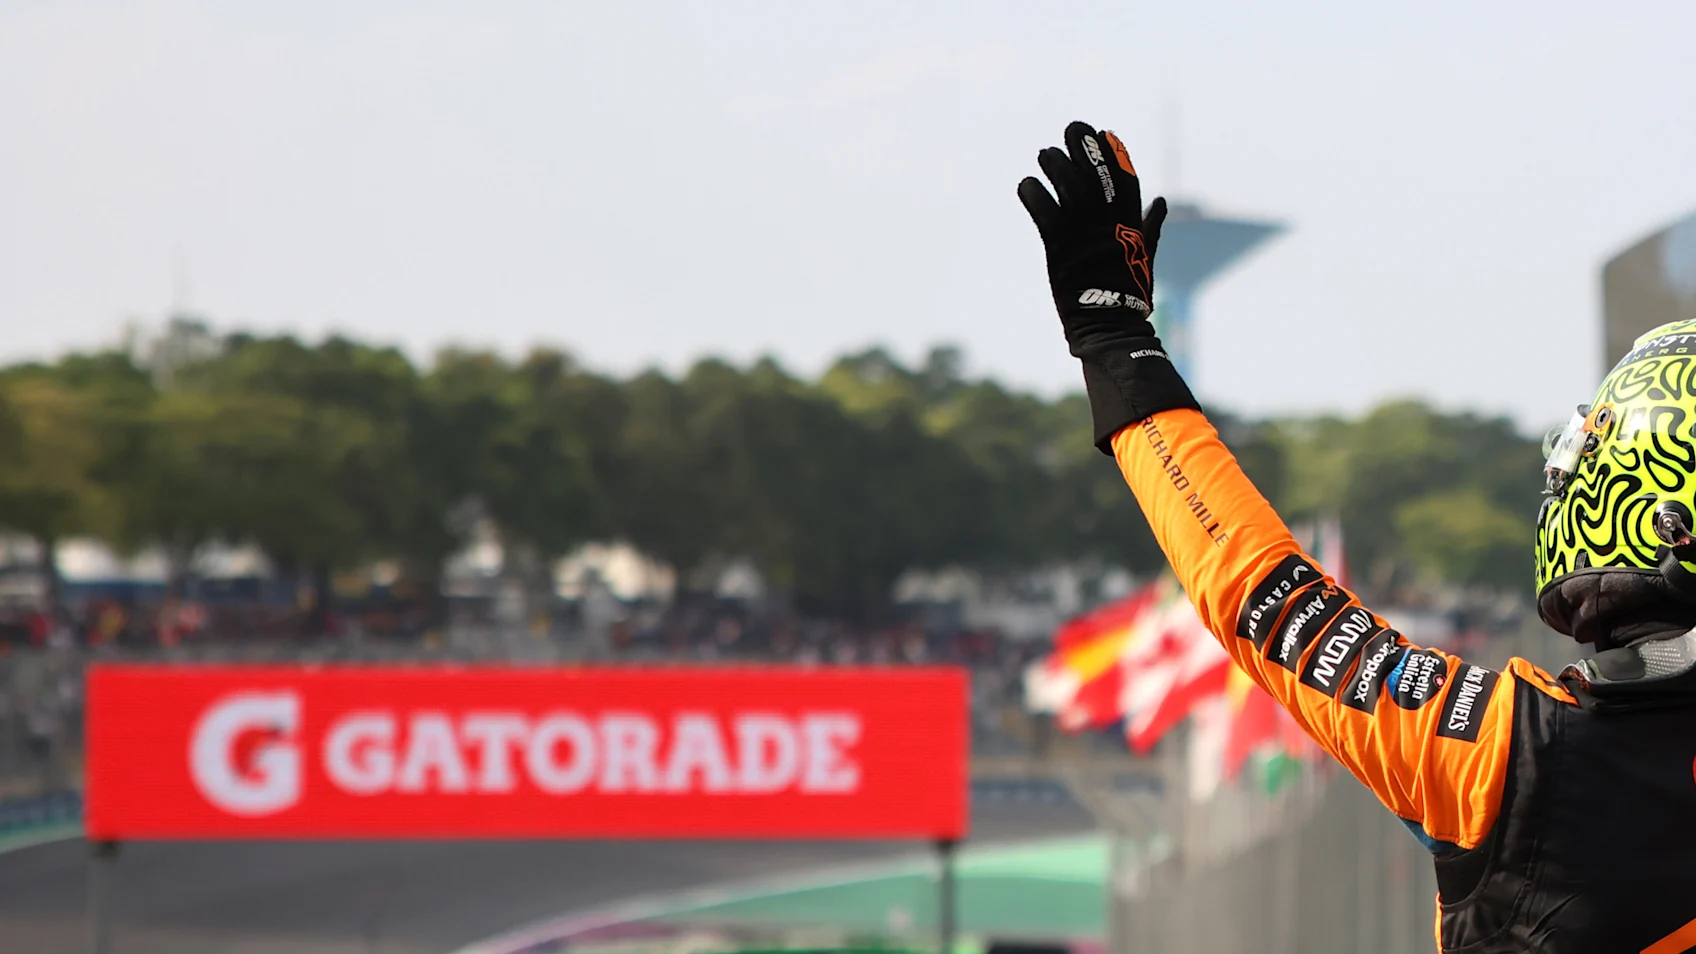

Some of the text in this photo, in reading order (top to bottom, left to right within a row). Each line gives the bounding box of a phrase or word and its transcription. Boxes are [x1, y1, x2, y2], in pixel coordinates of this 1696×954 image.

[1096, 166, 1113, 203] NUTRITION
[1078, 288, 1121, 307] ON
[1142, 415, 1230, 547] RICHARD MILLE
[1278, 595, 1326, 663] Airwallex
[1398, 653, 1425, 693] Galicia
[1412, 655, 1440, 701] Estrella
[1448, 682, 1484, 732] DANIEL'S
[190, 688, 861, 818] G GATORADE
